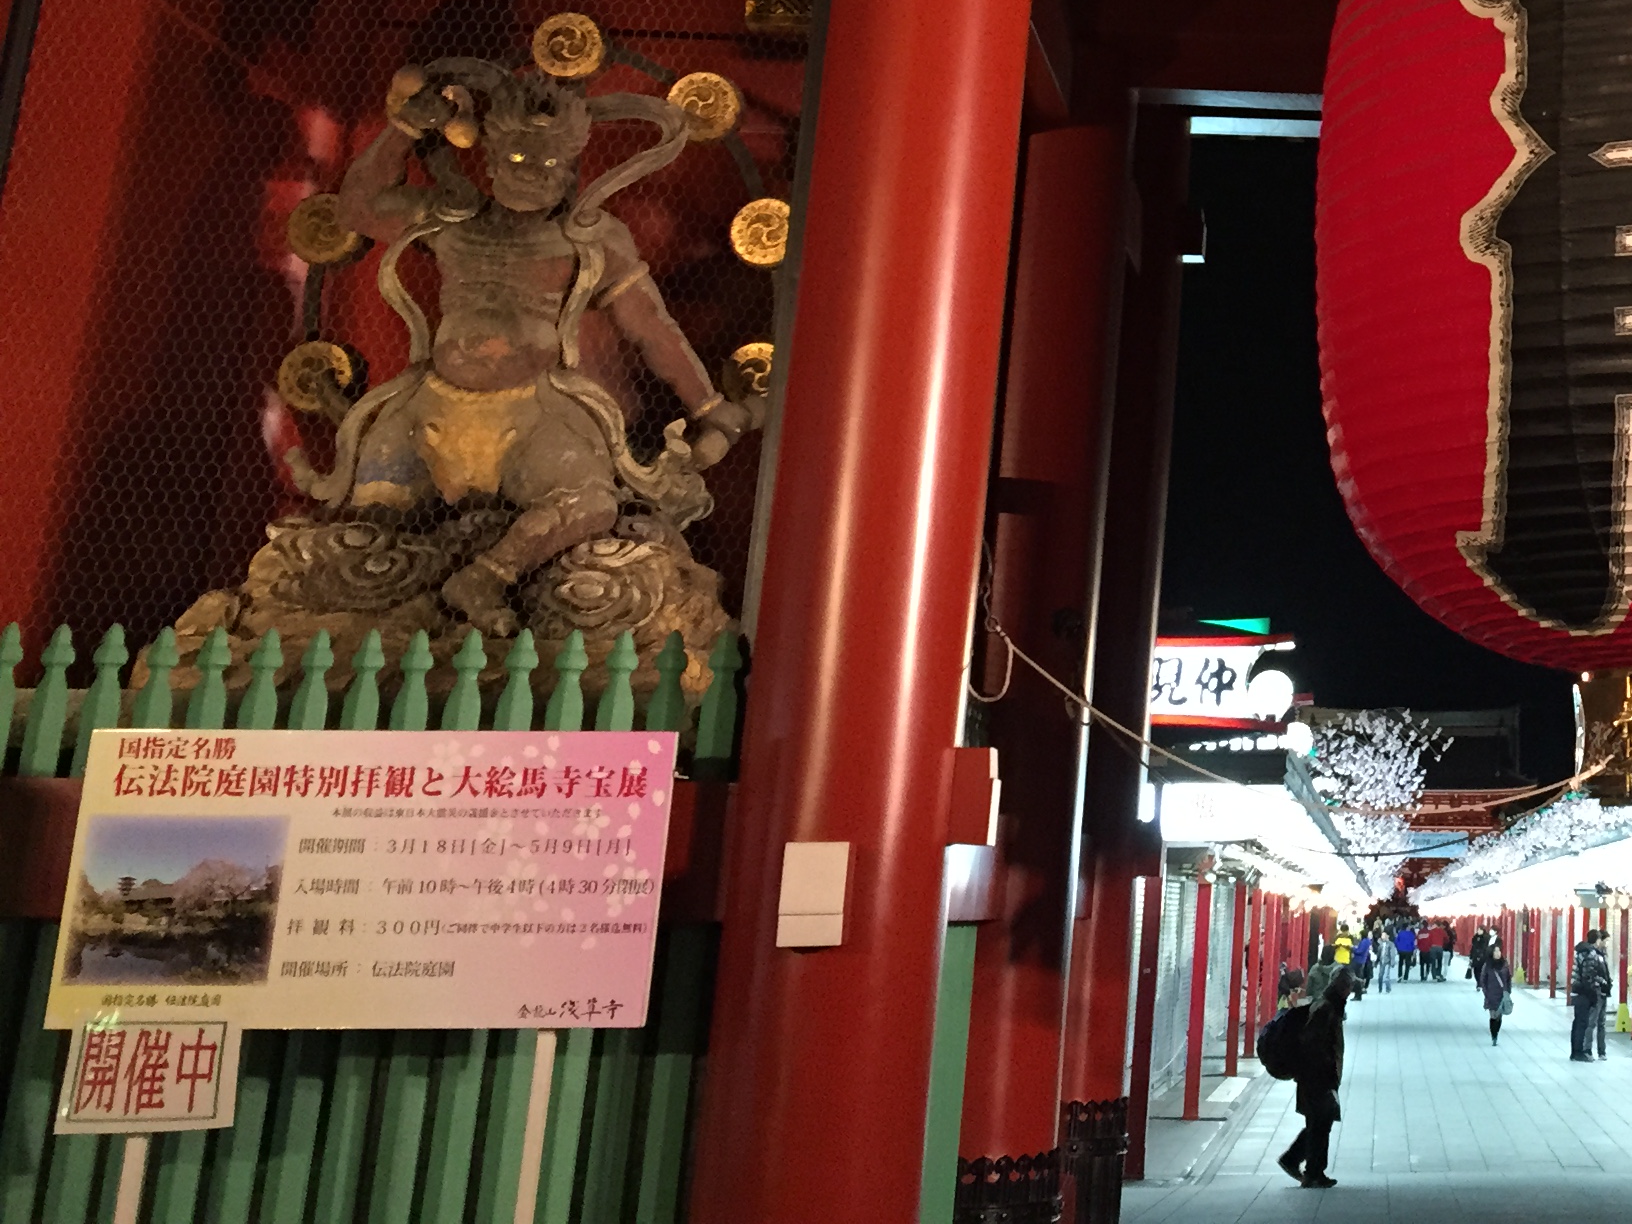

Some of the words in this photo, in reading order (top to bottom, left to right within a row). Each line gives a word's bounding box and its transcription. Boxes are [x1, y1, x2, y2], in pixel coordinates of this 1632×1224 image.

[117, 736, 237, 761] 国指定名勝
[113, 762, 649, 799] 伝法院庭園特別拝観と大絵馬寺宝展
[73, 1027, 218, 1116] 開催中
